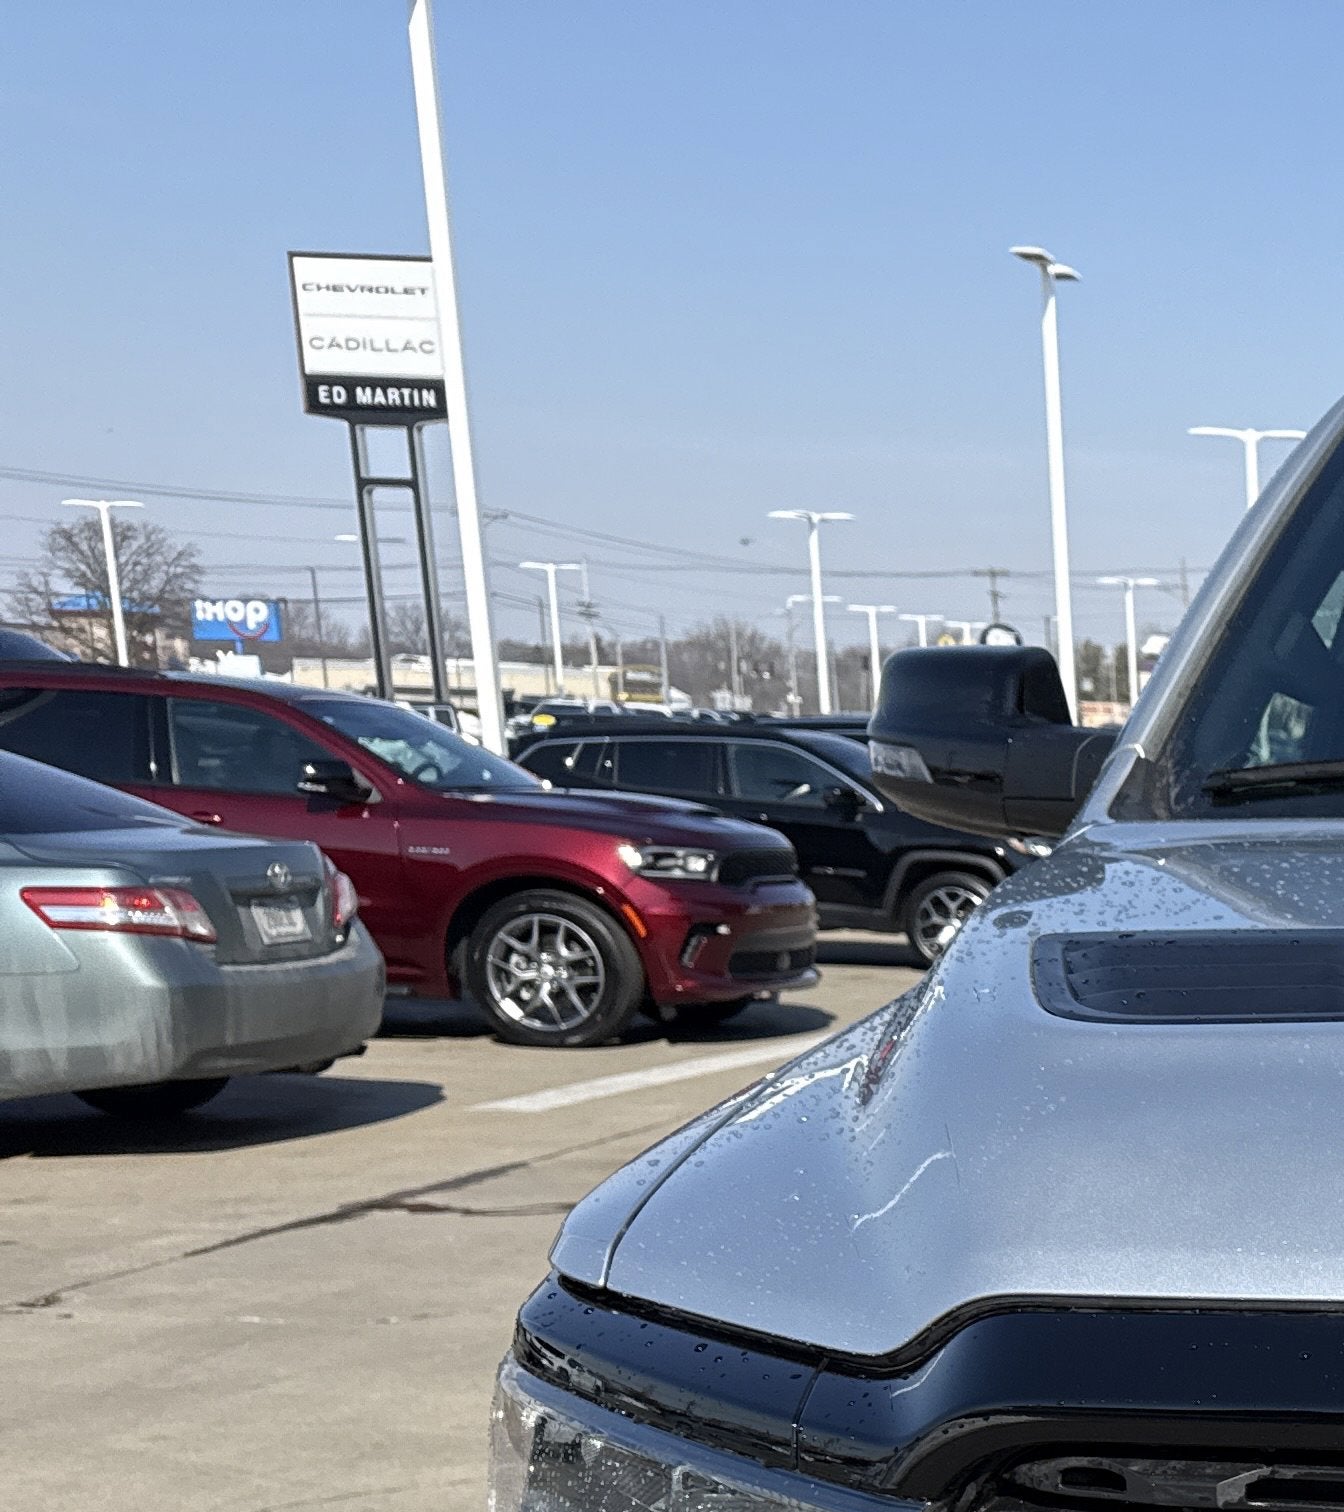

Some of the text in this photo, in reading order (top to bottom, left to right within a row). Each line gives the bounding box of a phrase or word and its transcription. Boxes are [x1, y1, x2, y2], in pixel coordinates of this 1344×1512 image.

[302, 282, 429, 296] CHEVROLET
[308, 335, 436, 354] CADILLAC
[318, 384, 438, 409] ED MARTIN
